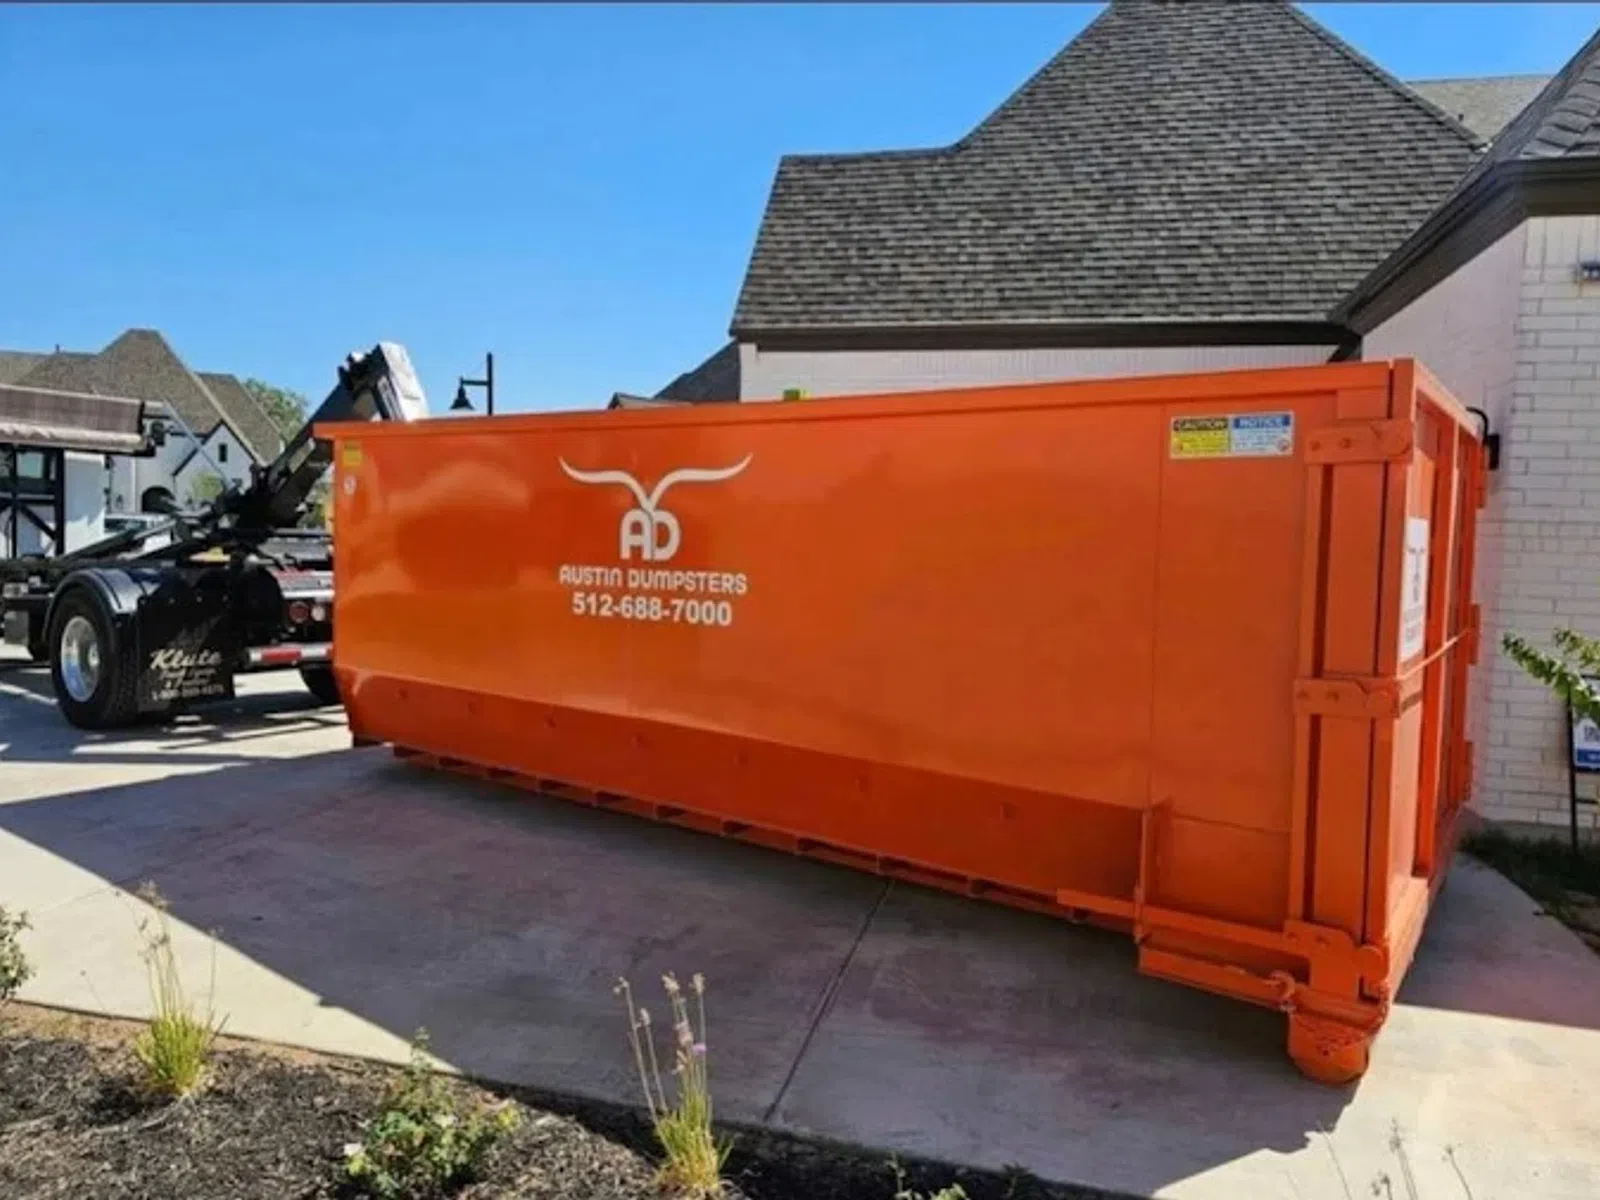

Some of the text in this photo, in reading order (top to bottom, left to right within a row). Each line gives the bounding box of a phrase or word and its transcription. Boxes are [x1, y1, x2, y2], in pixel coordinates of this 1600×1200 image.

[620, 509, 681, 560] AD
[559, 564, 748, 595] AUSTIN DUMPSTERS
[572, 591, 732, 626] 512-688-7000
